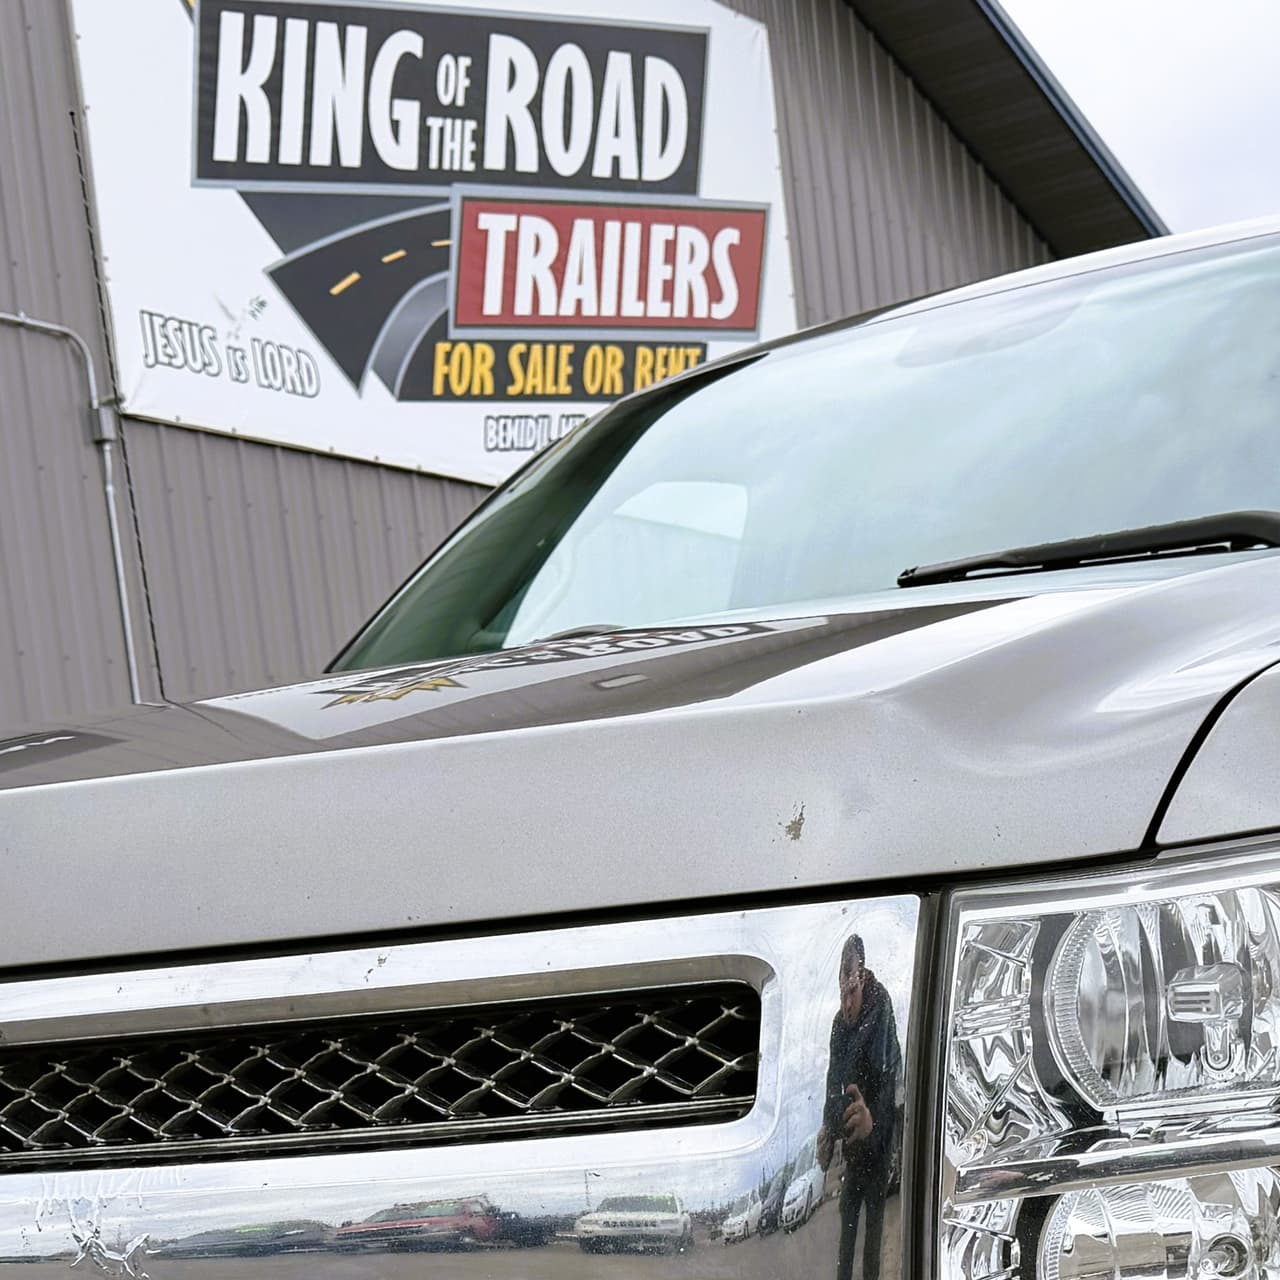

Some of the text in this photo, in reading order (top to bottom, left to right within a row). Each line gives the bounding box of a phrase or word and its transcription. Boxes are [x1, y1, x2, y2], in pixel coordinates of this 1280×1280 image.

[213, 9, 689, 182] KING OF THE ROAD
[477, 212, 740, 320] TRAILERS
[140, 310, 321, 398] JESUS IS LORD
[433, 342, 495, 396] FOR
[508, 344, 576, 396] SALE
[583, 344, 624, 396] OR
